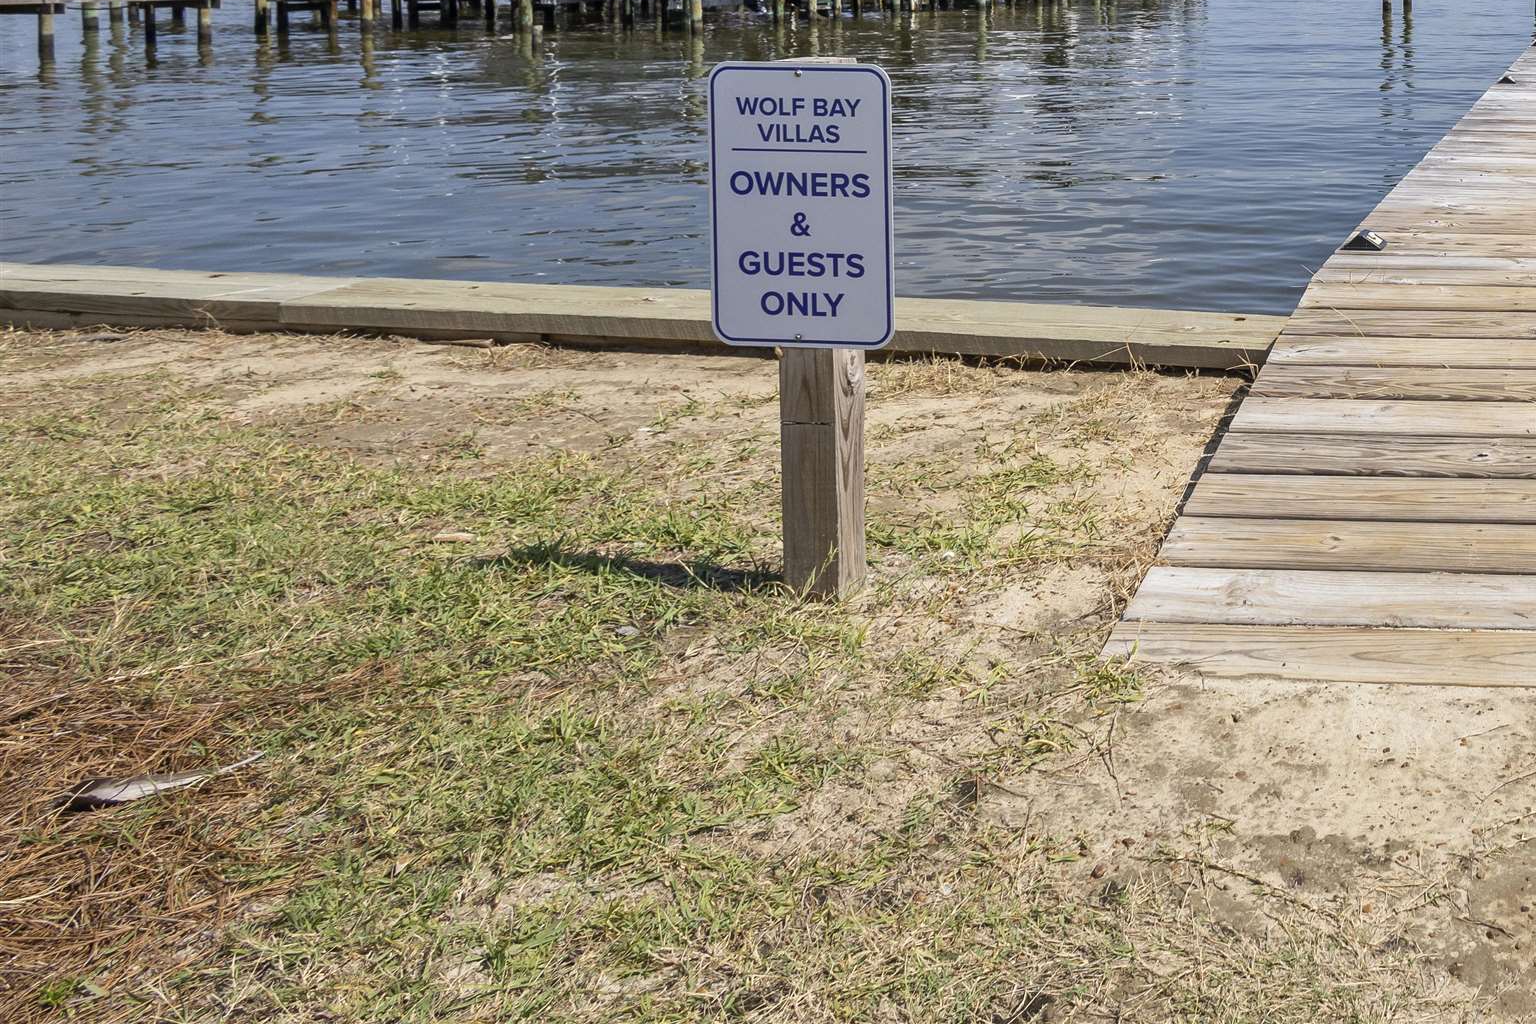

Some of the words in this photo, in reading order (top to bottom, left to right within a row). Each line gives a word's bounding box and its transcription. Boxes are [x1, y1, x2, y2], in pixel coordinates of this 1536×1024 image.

[736, 97, 805, 116] WOLF
[813, 98, 861, 117] BAY
[757, 124, 840, 143] VILLAS
[730, 170, 870, 198] OWNERS
[790, 212, 811, 236] &
[738, 250, 865, 278] GUESTS
[760, 291, 844, 317] ONLY
